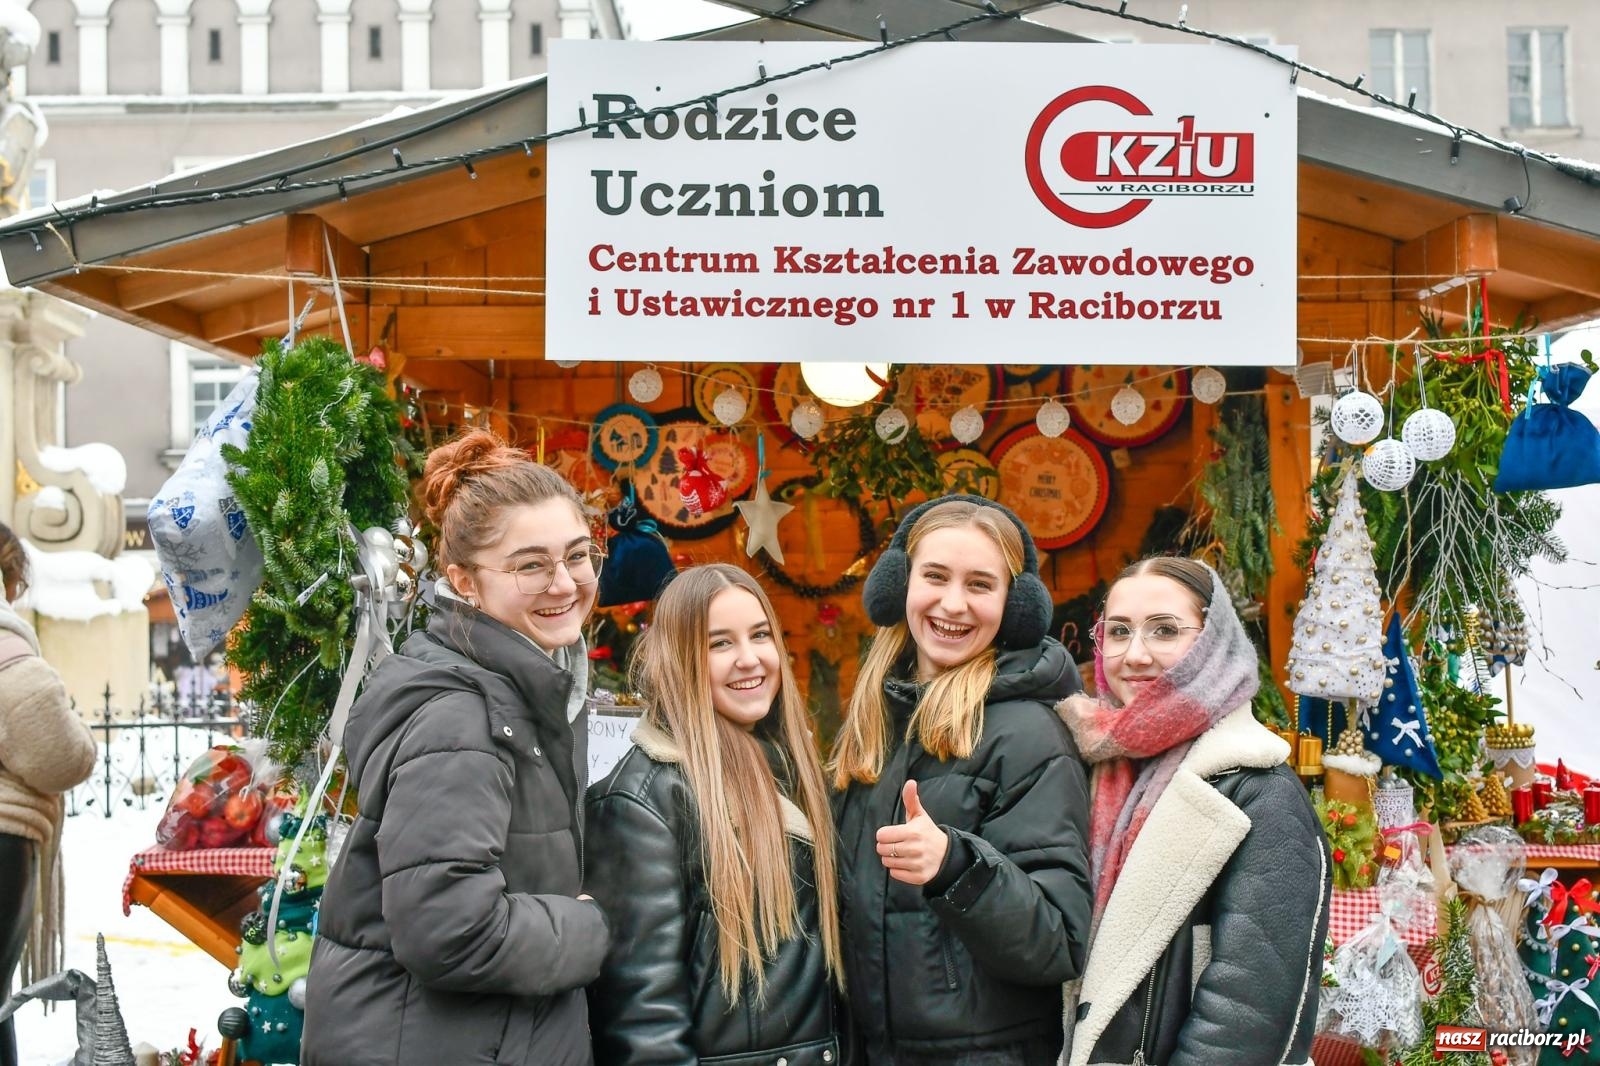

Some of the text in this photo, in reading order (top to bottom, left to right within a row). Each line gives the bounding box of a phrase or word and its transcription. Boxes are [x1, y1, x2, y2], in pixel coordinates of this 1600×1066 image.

[592, 94, 857, 142] Rodzice
[590, 169, 884, 217] Uczniom
[1120, 184, 1254, 193] RACIBORZU
[588, 245, 1253, 283] Centrum Kształcenia Zawodowego
[590, 288, 1221, 325] i Ustawicznego nr 1 w Raciborzu
